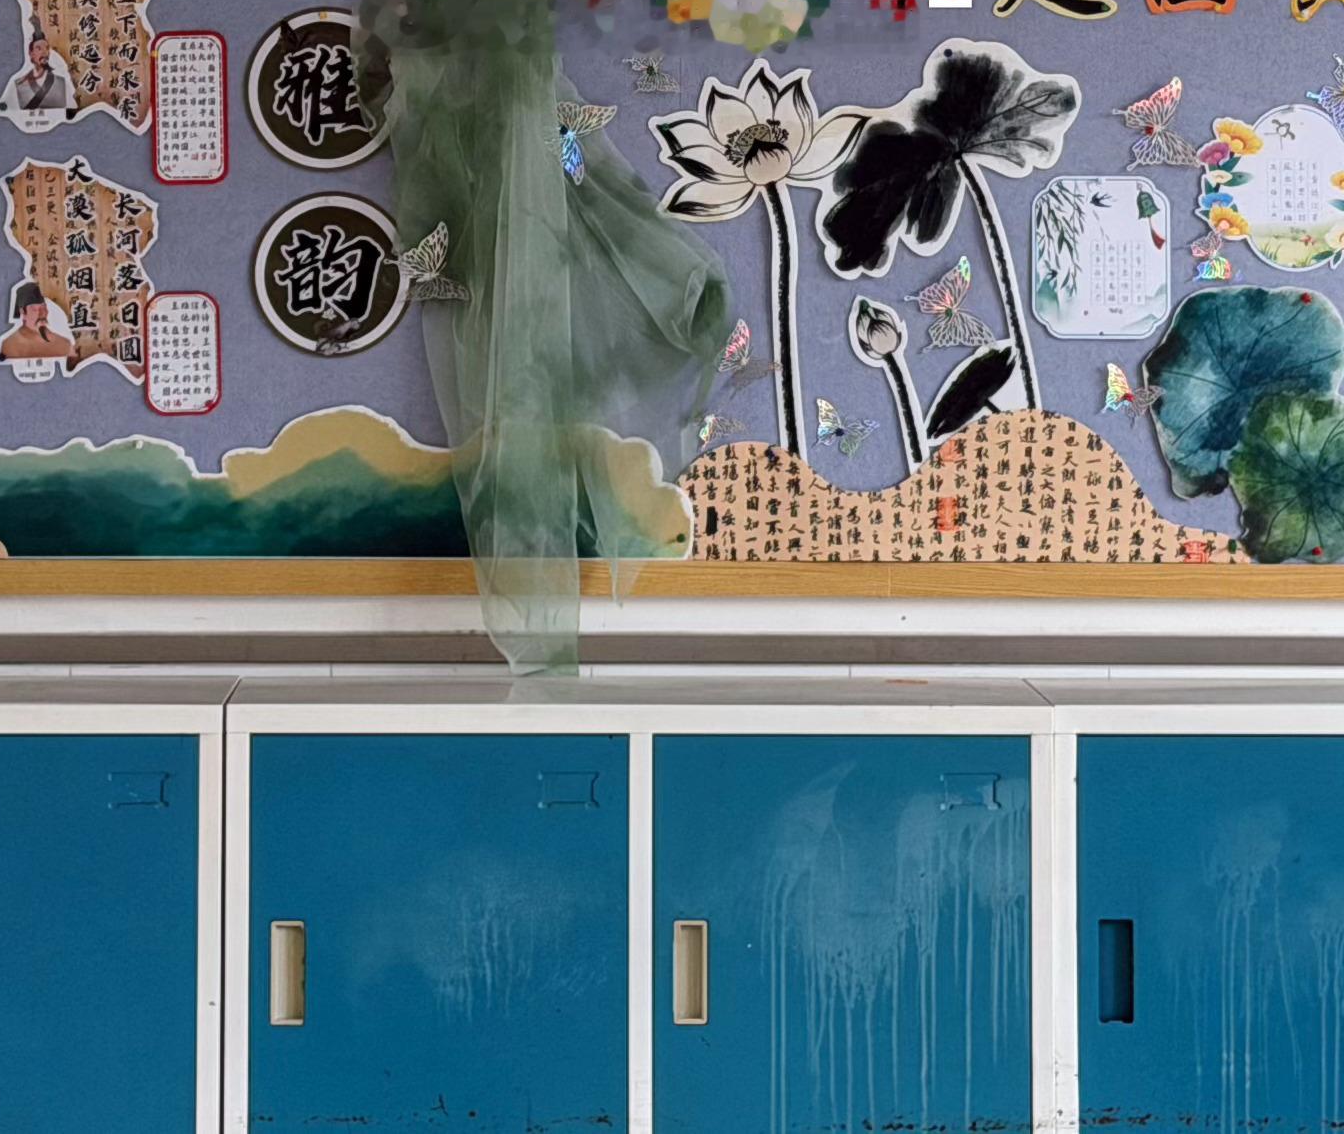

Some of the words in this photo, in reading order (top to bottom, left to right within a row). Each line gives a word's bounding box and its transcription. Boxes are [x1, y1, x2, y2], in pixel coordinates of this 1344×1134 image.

[66, 160, 96, 331] 大漠孤烟直
[115, 193, 144, 363] 长河落日圆
